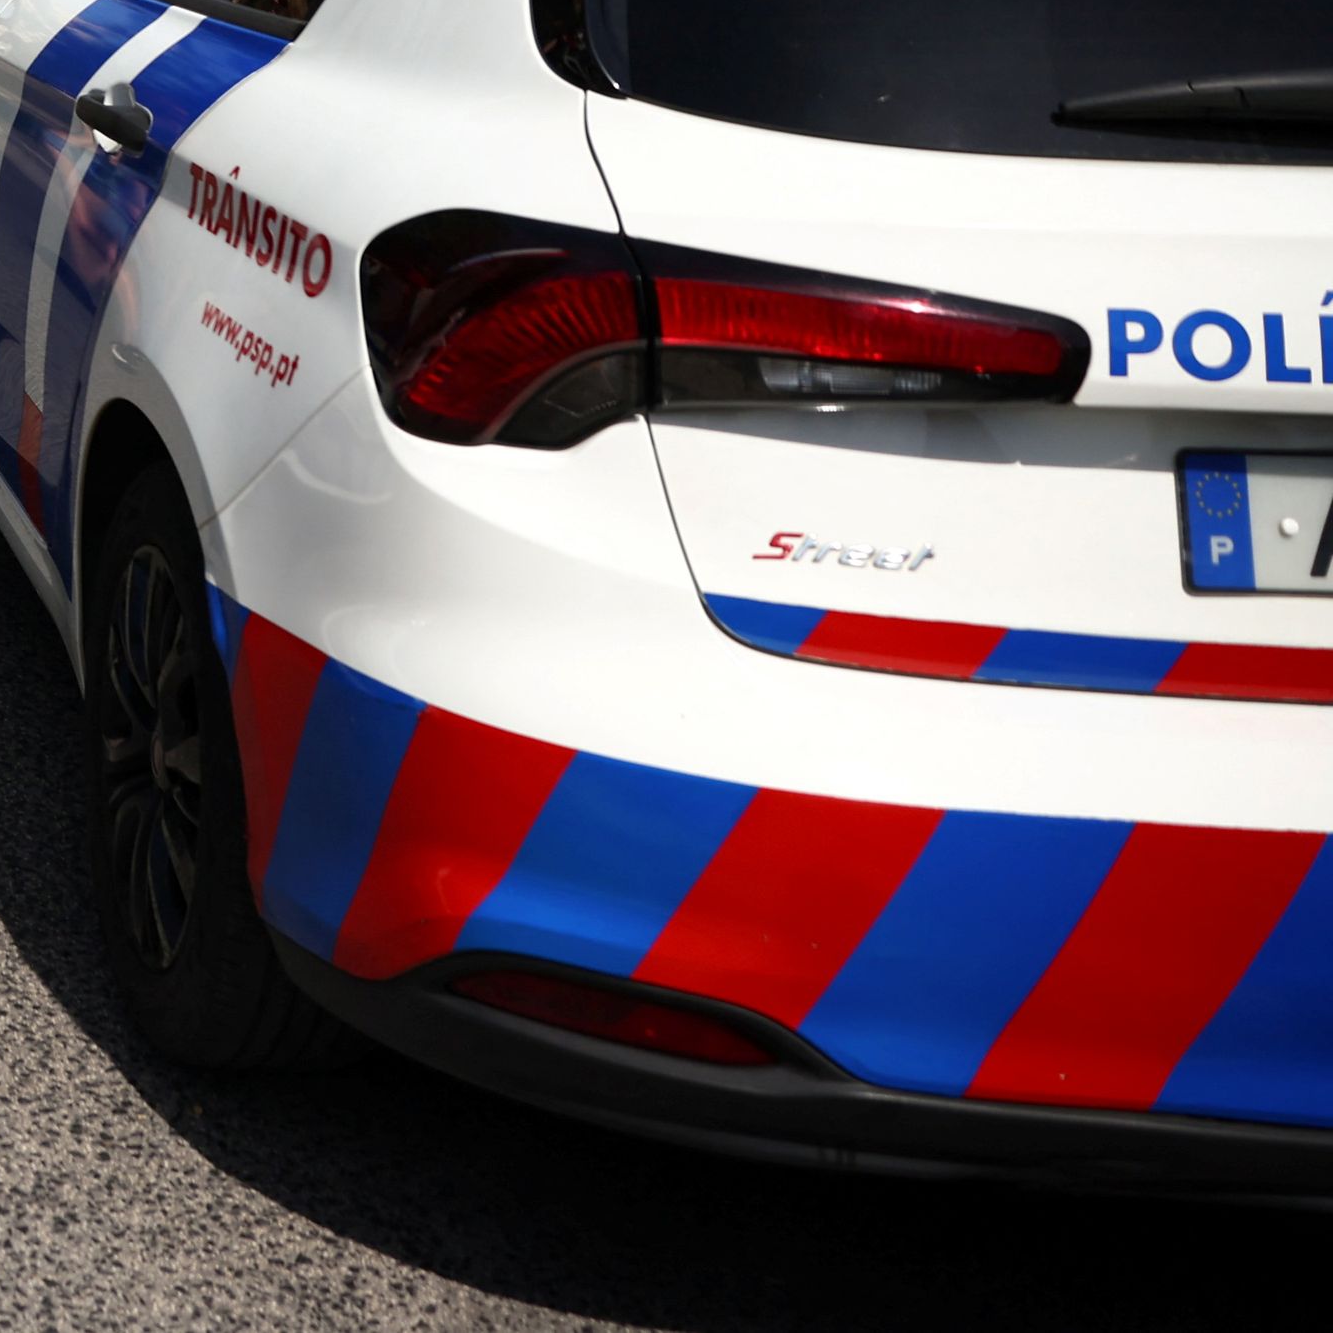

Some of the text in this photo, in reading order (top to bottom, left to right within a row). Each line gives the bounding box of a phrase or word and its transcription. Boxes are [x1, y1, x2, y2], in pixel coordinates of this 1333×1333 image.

[187, 162, 332, 298] TRÂNSITO
[201, 301, 300, 388] www.psp.pt
[752, 531, 935, 572] Street
[1210, 535, 1234, 565] P
